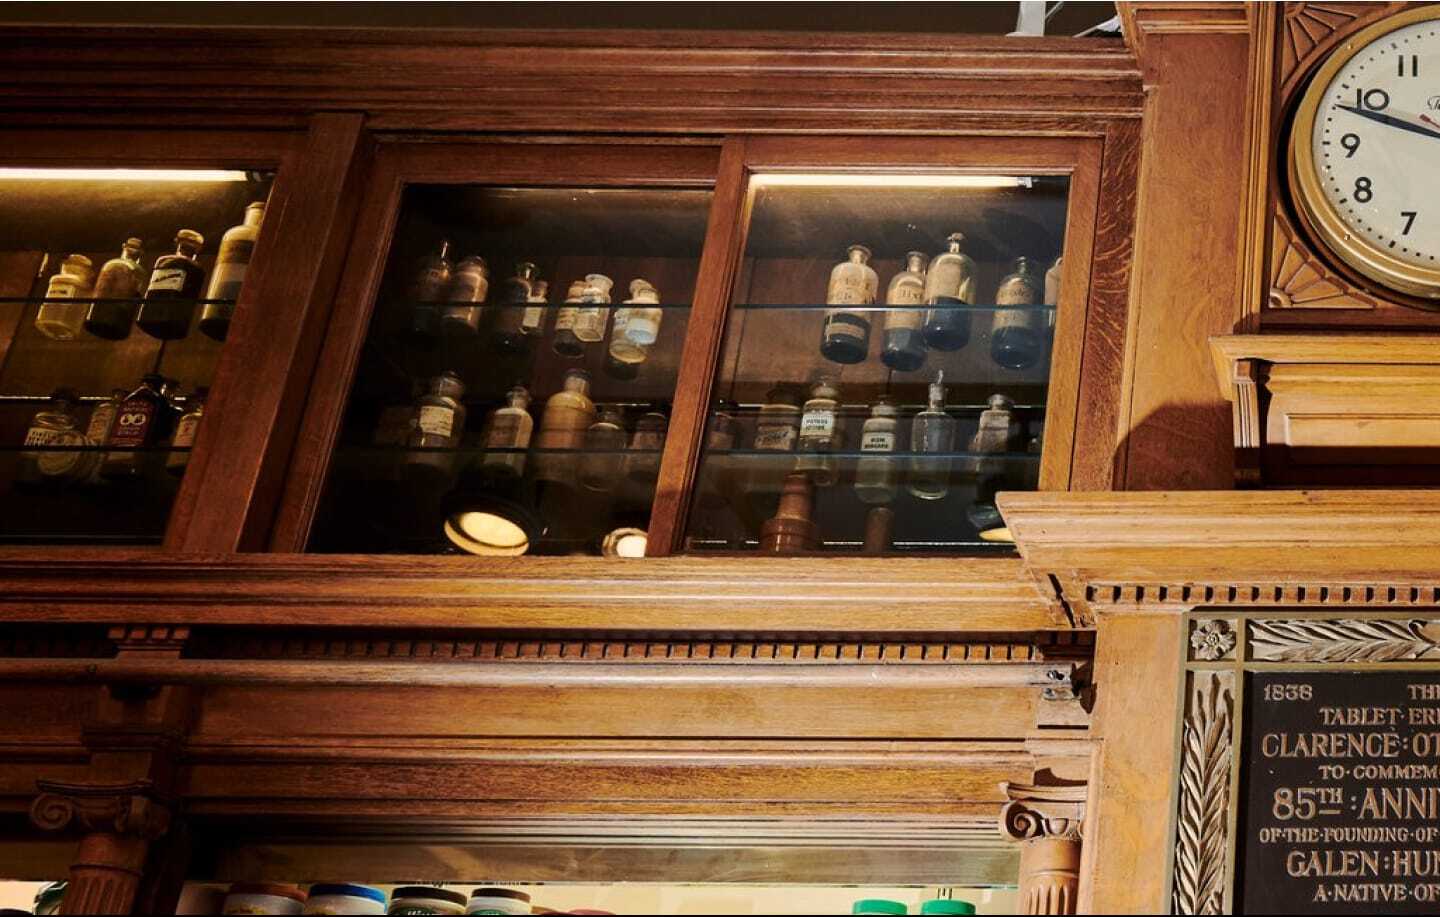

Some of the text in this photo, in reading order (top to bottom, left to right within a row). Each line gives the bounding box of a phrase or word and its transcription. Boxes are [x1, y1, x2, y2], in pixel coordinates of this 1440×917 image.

[1398, 54, 1419, 77] 11
[1356, 88, 1390, 111] 10
[1340, 133, 1360, 158] 9
[1354, 176, 1373, 203] 8
[1401, 211, 1417, 235] 7
[1263, 684, 1313, 700] 1838
[1319, 707, 1402, 726] TABLET
[1262, 732, 1401, 758] CLARENCE
[1318, 764, 1345, 780] TO
[1259, 827, 1282, 844] OF
[1284, 827, 1320, 844] THE
[1323, 827, 1409, 844] FOUNDING
[1415, 827, 1440, 844] OF
[1286, 850, 1379, 877] GALEN
[1312, 883, 1327, 902] A
[1334, 883, 1408, 902] NATIVE
